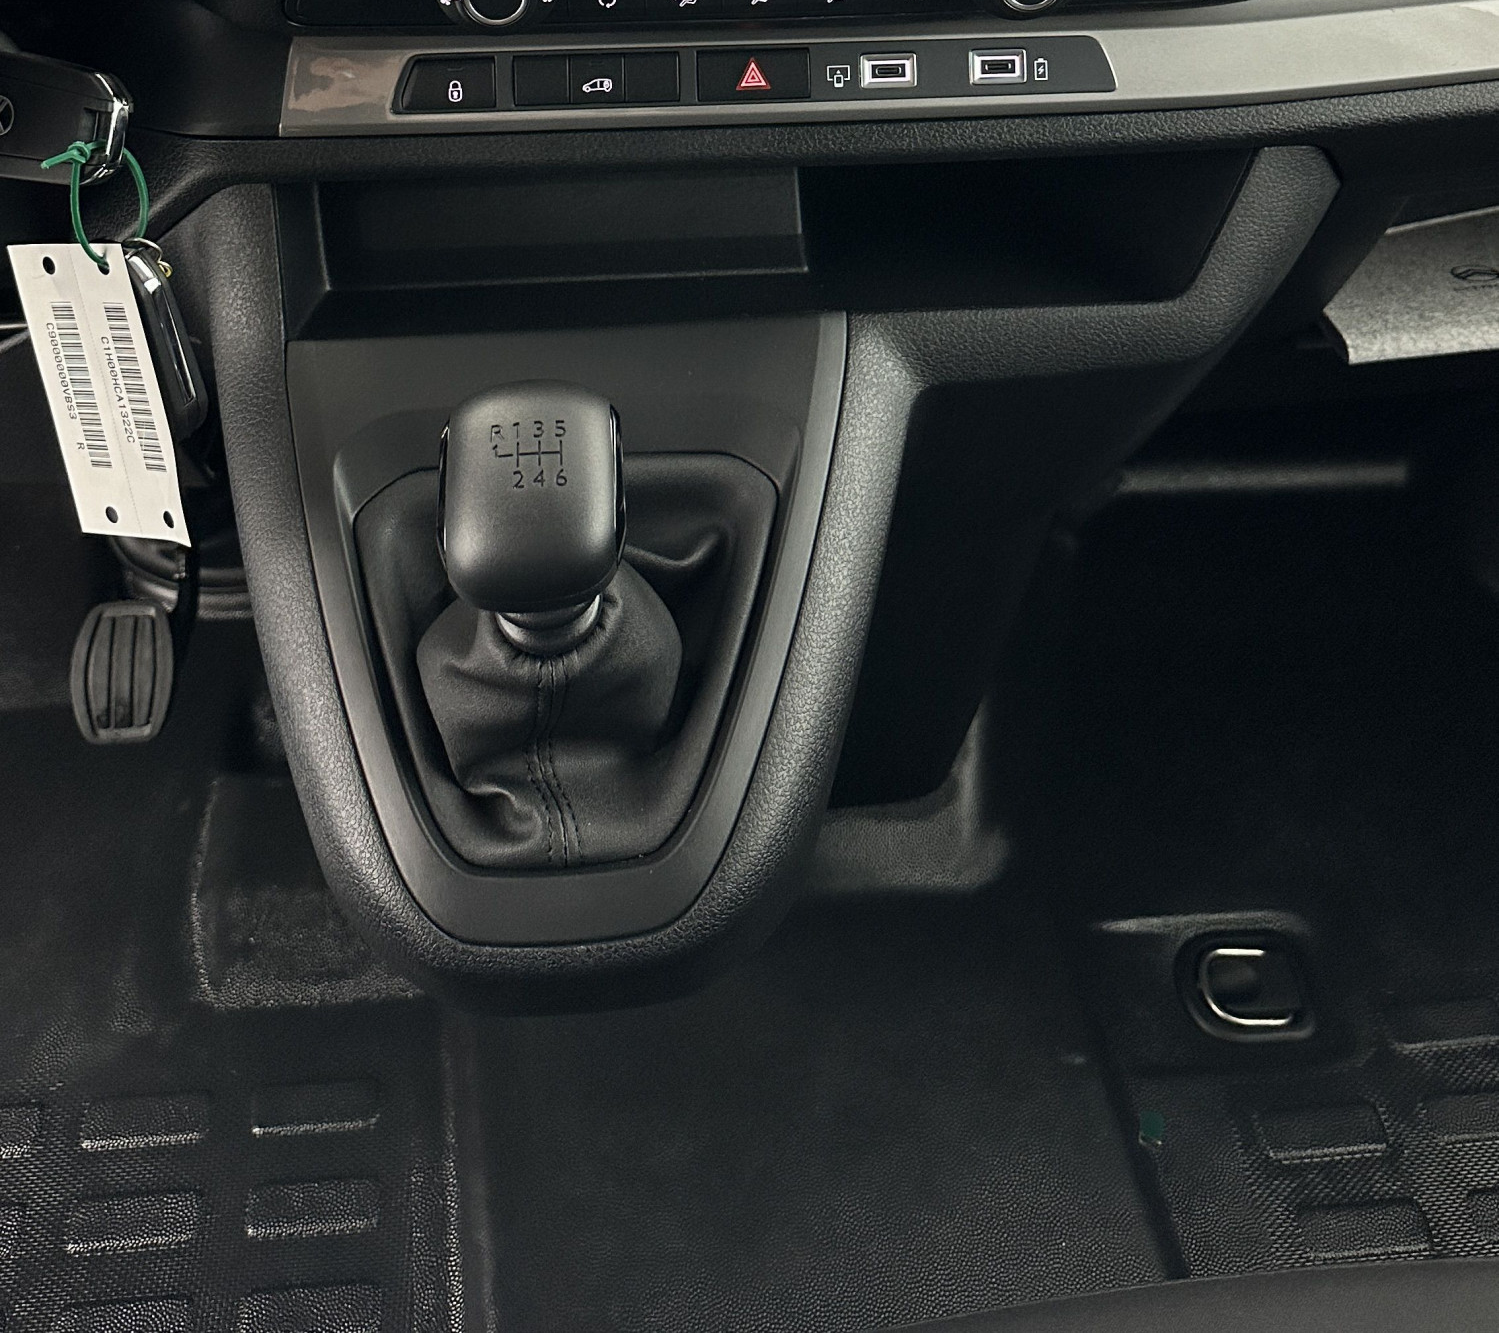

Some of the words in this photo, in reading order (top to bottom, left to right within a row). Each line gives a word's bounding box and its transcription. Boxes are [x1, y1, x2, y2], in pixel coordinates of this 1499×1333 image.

[490, 424, 504, 443] R
[512, 422, 520, 439] 1
[533, 420, 545, 438] 3
[555, 420, 567, 437] 5
[76, 441, 86, 450] R
[512, 470, 525, 489] 2
[533, 469, 546, 487] 4
[555, 468, 568, 486] 6
